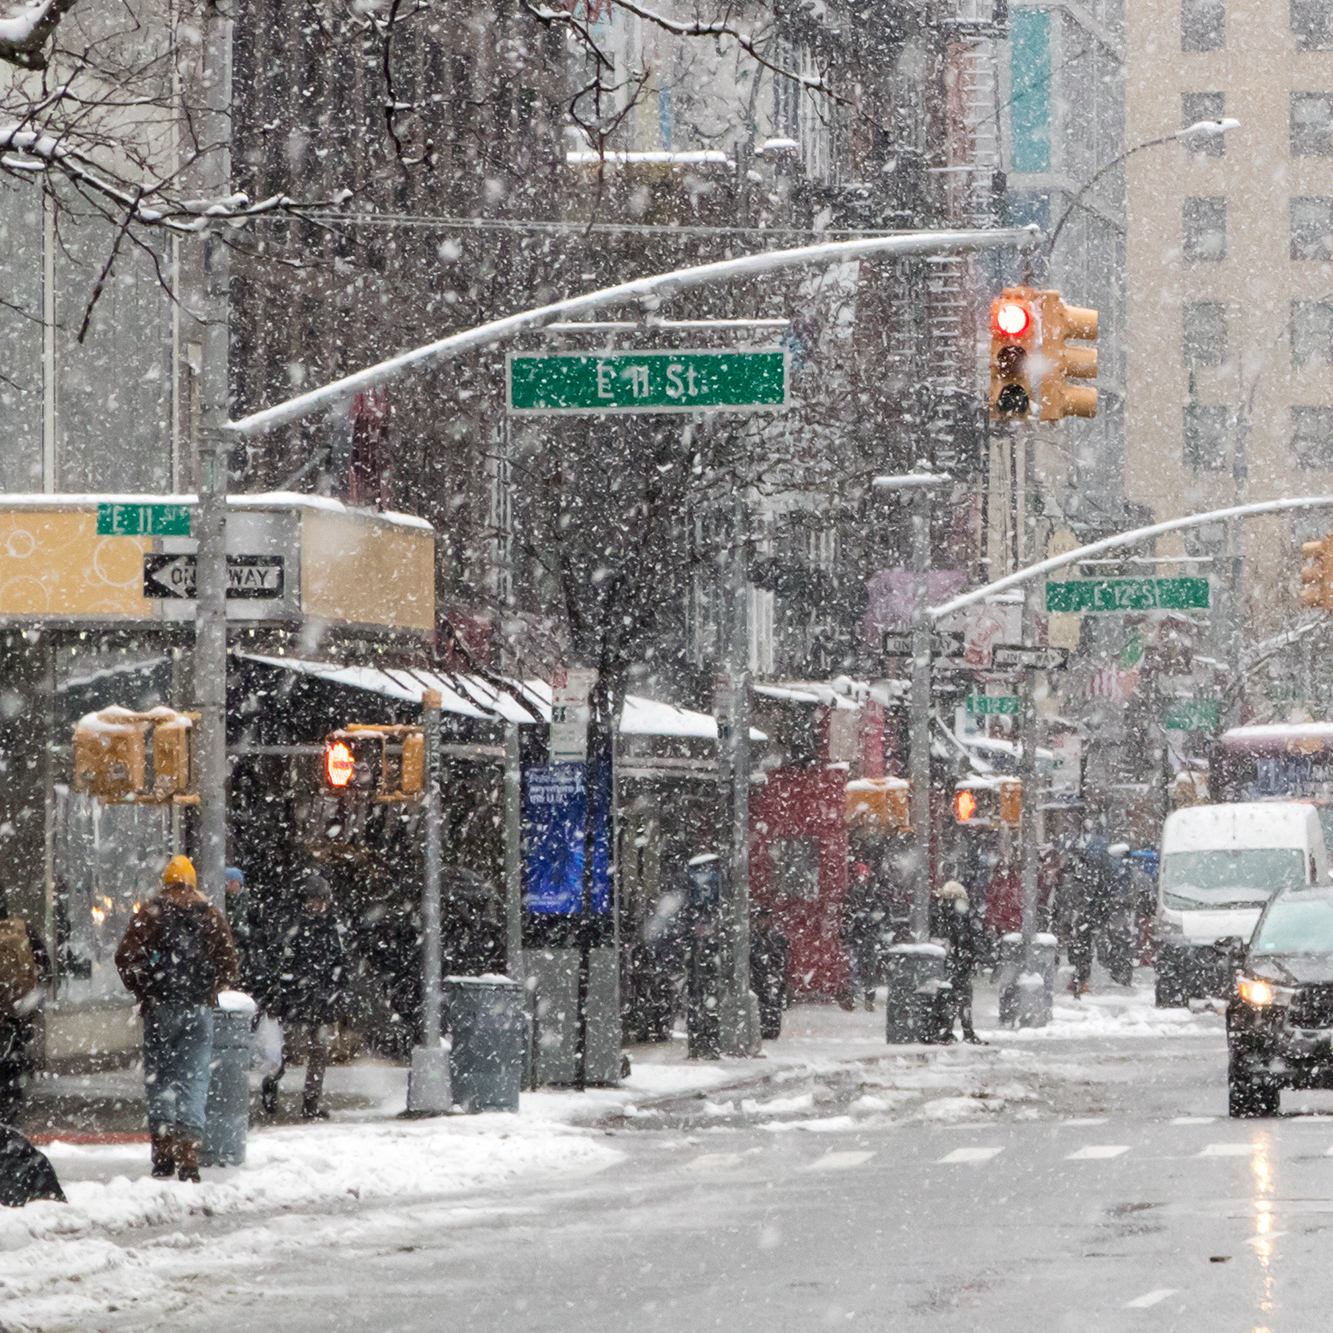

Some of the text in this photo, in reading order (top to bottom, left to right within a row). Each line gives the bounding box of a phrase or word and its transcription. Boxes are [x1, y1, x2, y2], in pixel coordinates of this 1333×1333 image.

[597, 364, 698, 399] E 11 St
[112, 505, 125, 533] E
[138, 506, 152, 533] 11
[170, 567, 269, 587] ON WAY
[1093, 585, 1105, 607] E
[1114, 585, 1136, 607] 12
[893, 640, 911, 651] ON
